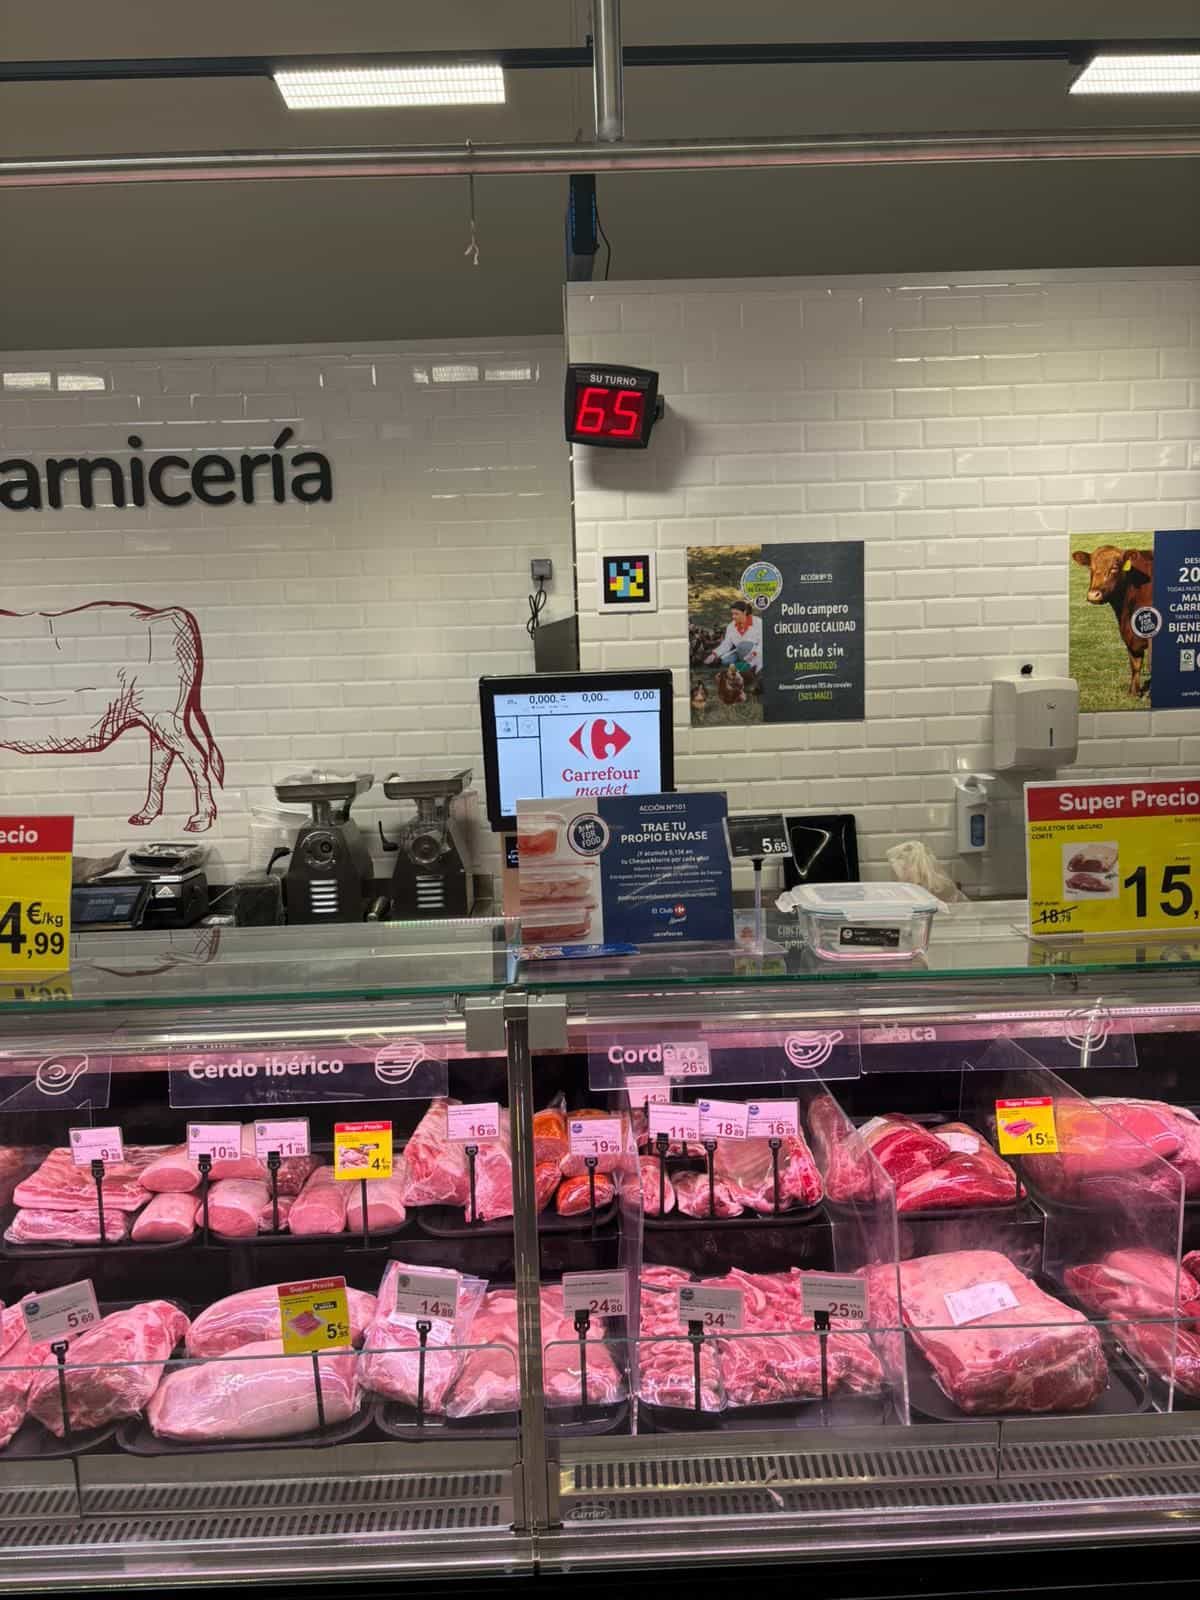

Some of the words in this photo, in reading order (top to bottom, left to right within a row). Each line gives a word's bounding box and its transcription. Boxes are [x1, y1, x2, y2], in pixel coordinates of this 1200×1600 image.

[589, 374, 602, 383] SU
[605, 375, 637, 386] TURNO
[576, 387, 642, 435] 65
[781, 603, 806, 616] Pollo
[807, 604, 849, 618] campero
[774, 621, 809, 634] CÍRCULO
[810, 622, 820, 633] DE
[821, 620, 856, 632] CALIDAD
[786, 642, 823, 658] Criado
[826, 642, 844, 656] sin
[562, 766, 640, 782] Carrefour
[575, 784, 629, 796] market
[1059, 793, 1125, 814] Super
[1131, 787, 1200, 807] Precio
[641, 822, 670, 832] TRAE
[671, 821, 686, 831] TU
[621, 833, 662, 843] PROPIO
[665, 831, 708, 841] ENVASE
[608, 1043, 698, 1064] Cordero
[188, 1059, 257, 1079] Cerdo
[265, 1055, 344, 1076] ibérico
[469, 1124, 485, 1136] 16
[670, 1126, 684, 1138] 11
[717, 1122, 733, 1135] 18
[768, 1123, 785, 1135] 16
[210, 1146, 226, 1158] 10
[592, 1140, 608, 1152] 19
[101, 1149, 109, 1160] 9
[421, 1300, 440, 1316] 14
[590, 1299, 609, 1313] 24
[828, 1302, 849, 1317] 25
[67, 1312, 79, 1328] 5
[704, 1311, 725, 1327] 34
[327, 1323, 337, 1339] 5
